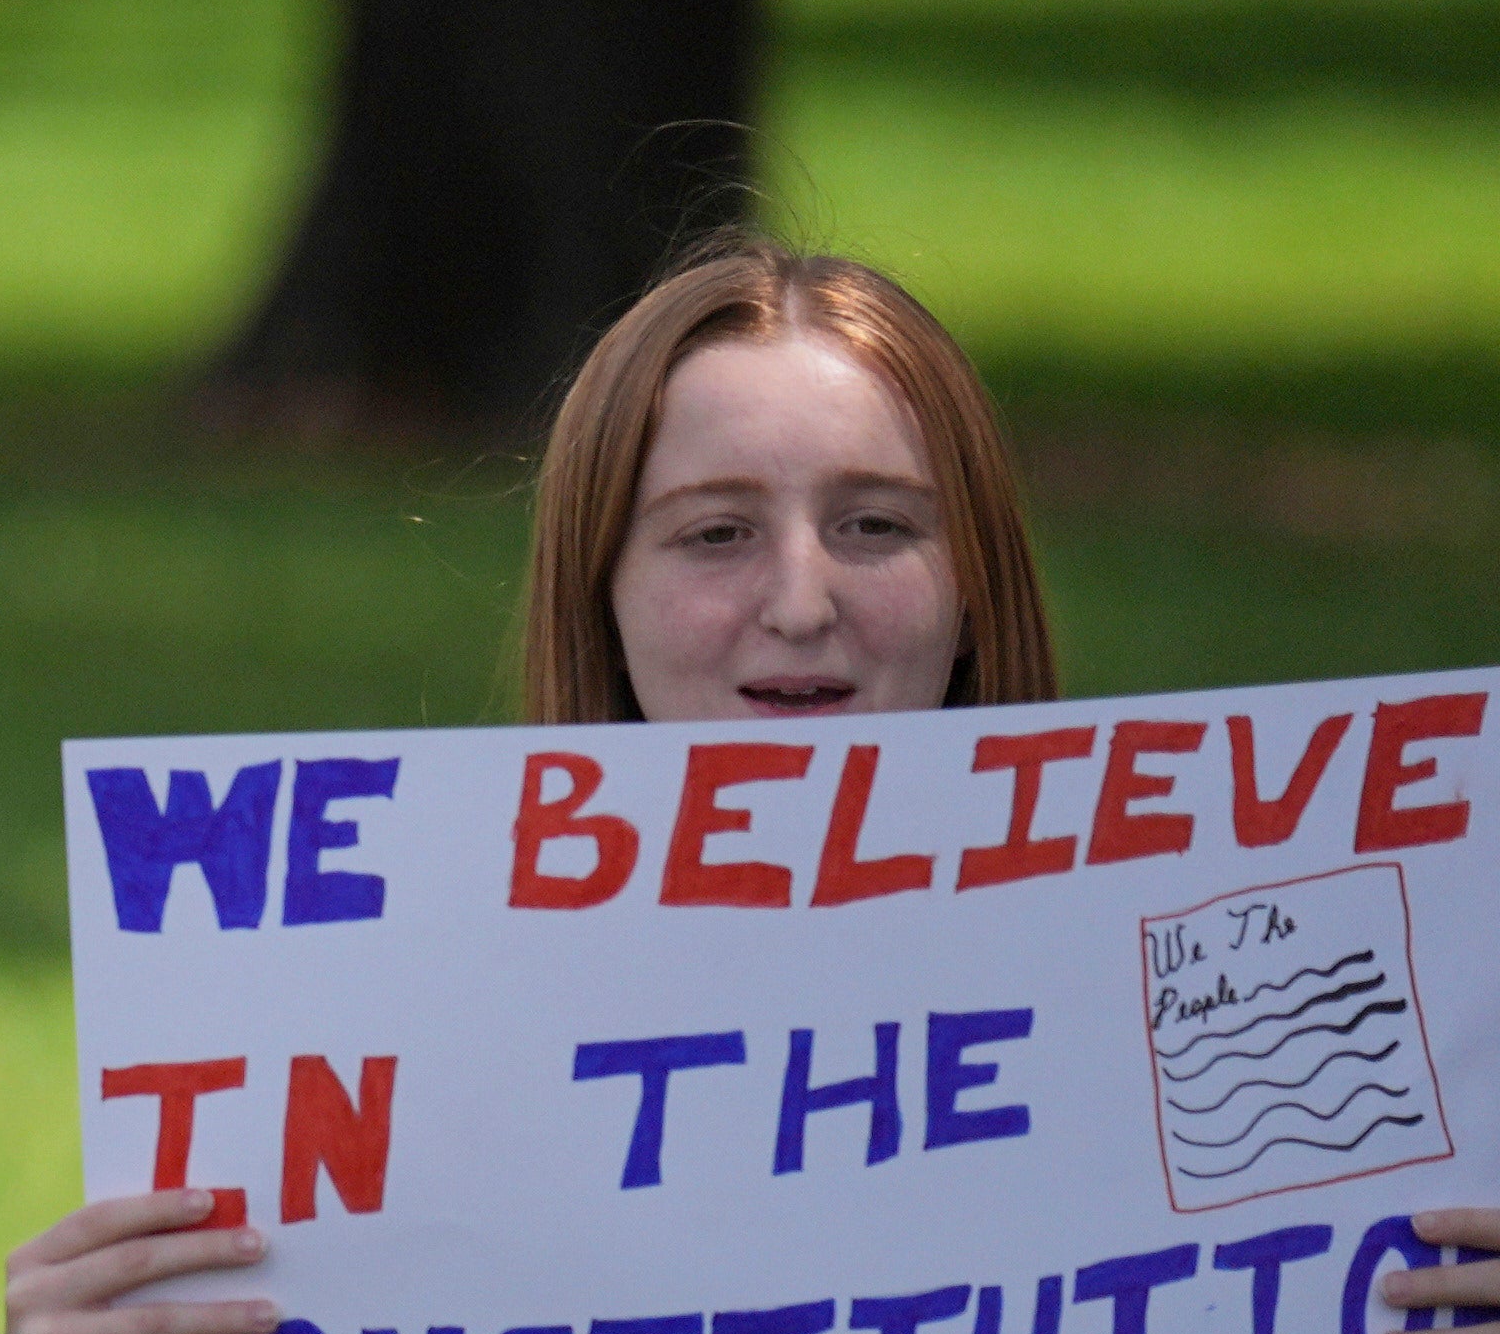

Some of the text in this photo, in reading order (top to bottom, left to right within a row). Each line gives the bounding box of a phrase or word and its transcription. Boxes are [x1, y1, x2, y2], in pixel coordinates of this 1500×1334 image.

[86, 691, 1489, 933] WE BELIEVE
[1146, 904, 1298, 978] We The
[101, 1007, 1035, 1230] IN THE
